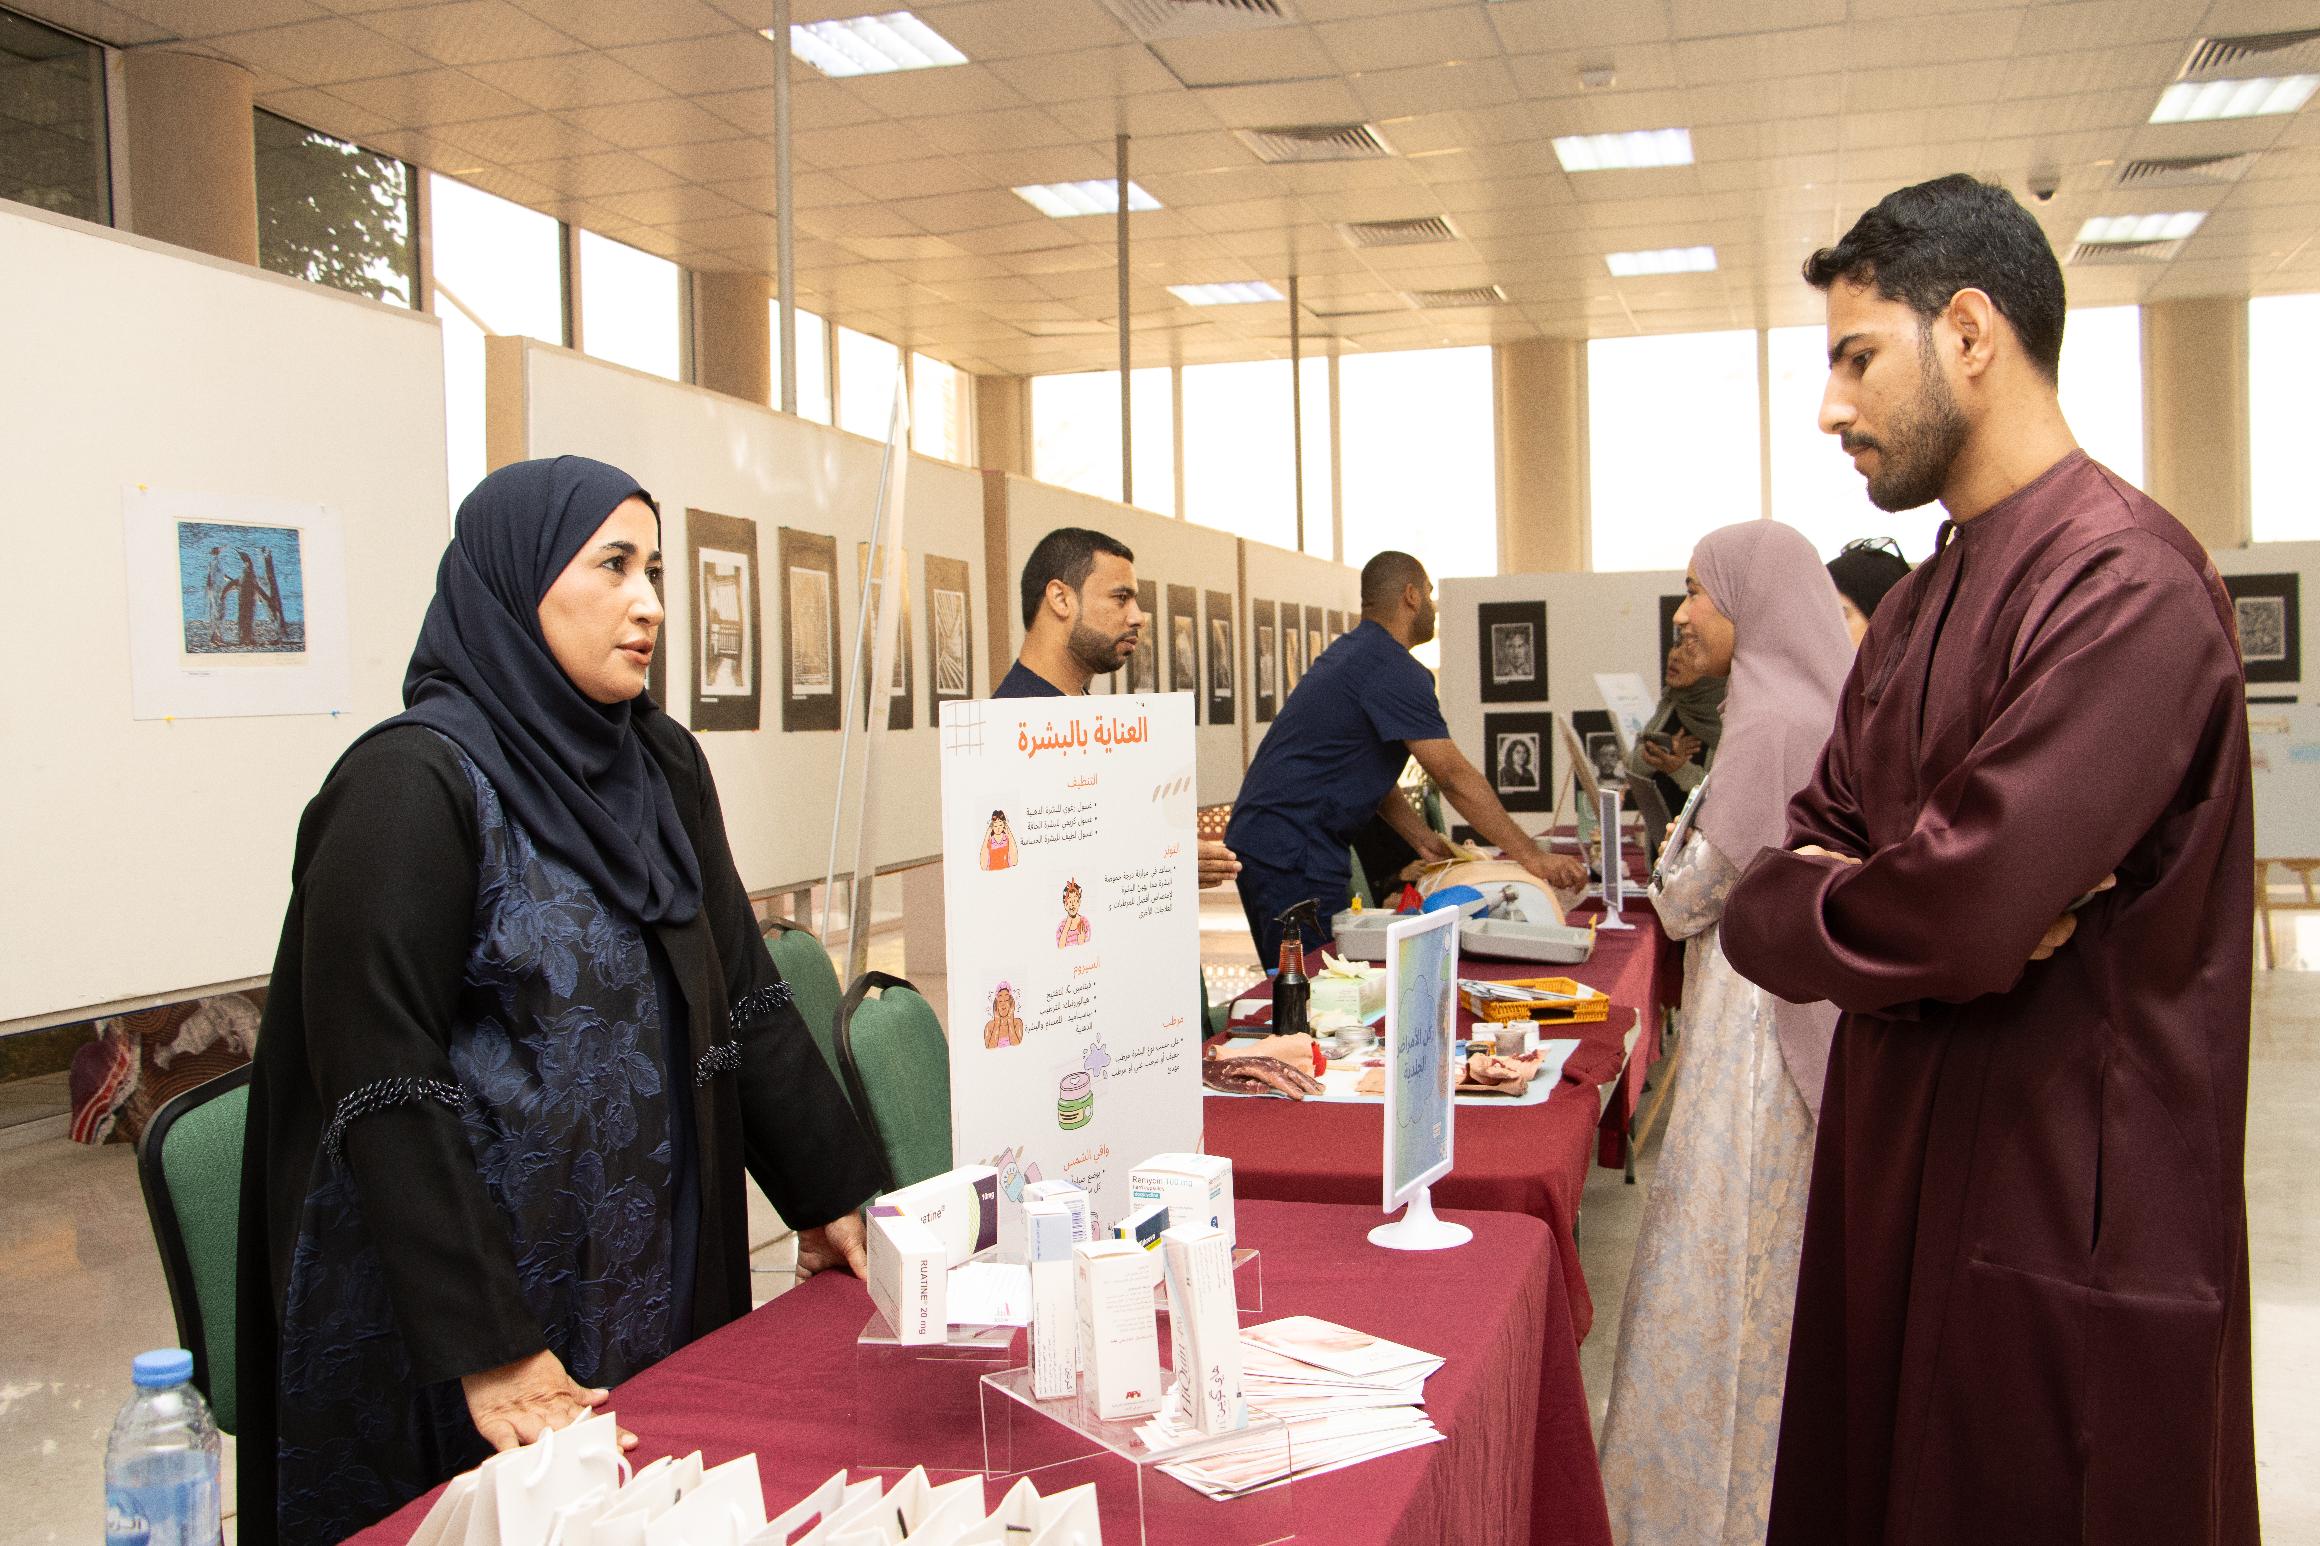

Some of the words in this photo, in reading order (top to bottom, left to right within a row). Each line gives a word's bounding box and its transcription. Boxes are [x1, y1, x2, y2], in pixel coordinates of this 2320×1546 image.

[1017, 720, 1088, 758] بالبشرة
[1094, 715, 1148, 753] العناية
[1067, 773, 1098, 789] التنظيف
[1403, 1056, 1427, 1085] الجلدية
[920, 1307, 928, 1318] 20
[918, 1321, 927, 1335] mg
